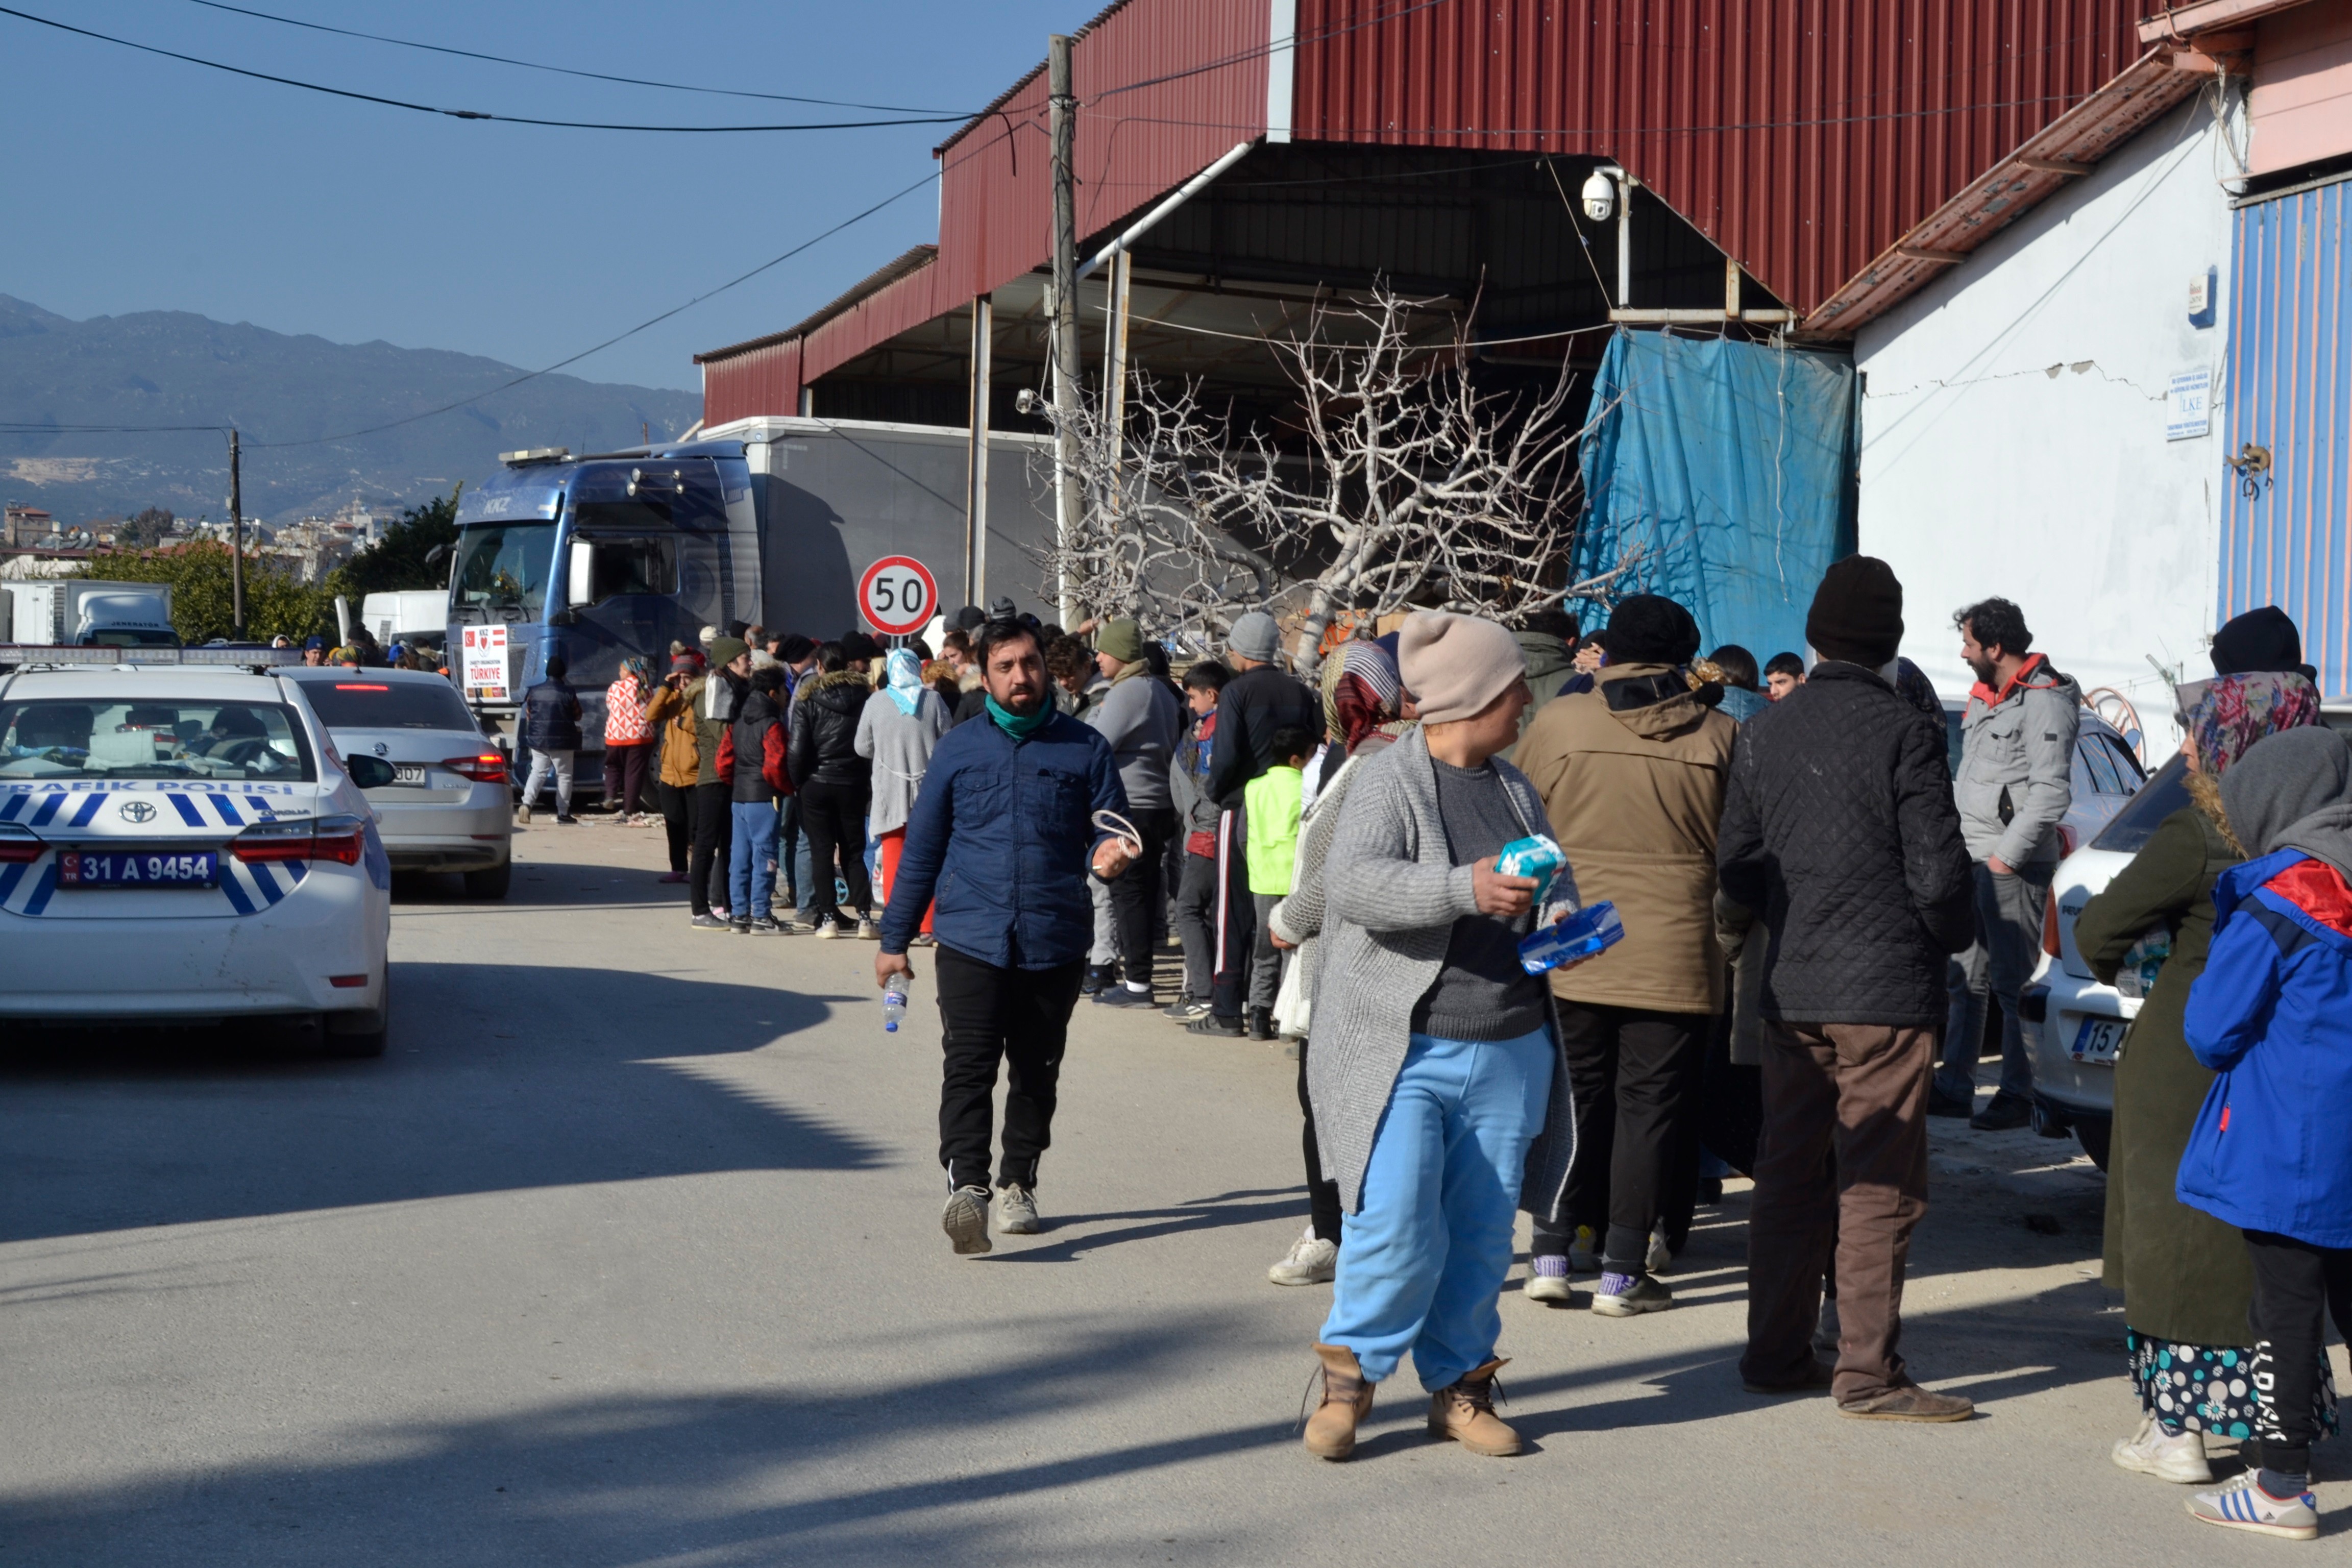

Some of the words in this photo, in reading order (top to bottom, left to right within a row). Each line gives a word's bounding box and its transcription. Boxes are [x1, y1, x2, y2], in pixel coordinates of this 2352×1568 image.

[483, 497, 511, 514] KKZ
[875, 577, 922, 613] 50
[156, 781, 293, 795] POLİSİ
[83, 857, 111, 880] 31
[121, 857, 140, 880] A
[148, 856, 209, 880] 9454
[2089, 1023, 2113, 1052] 15
